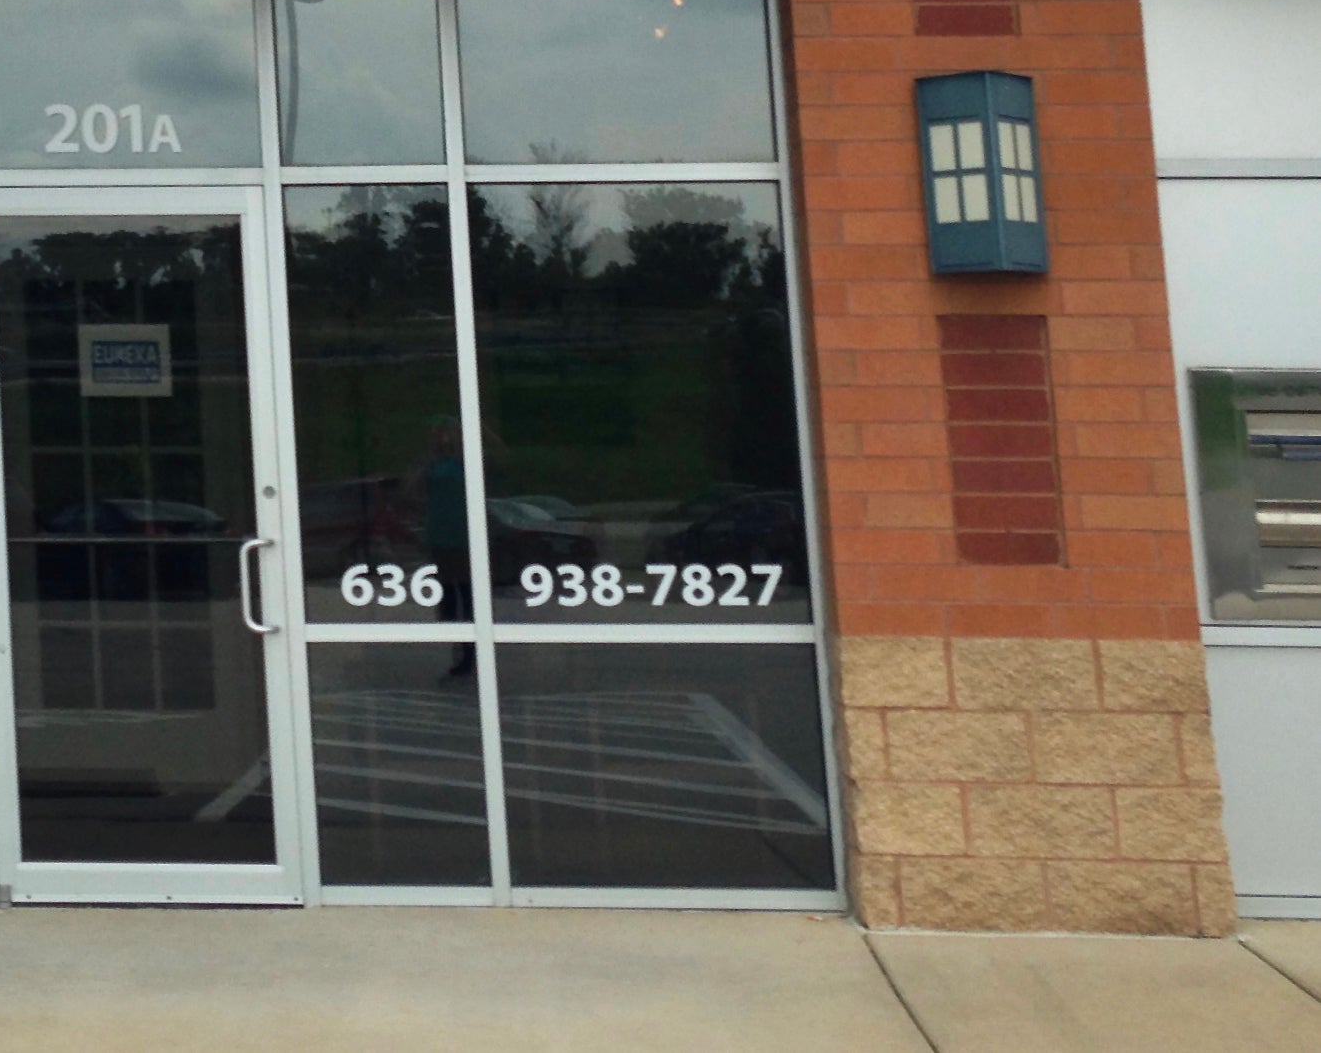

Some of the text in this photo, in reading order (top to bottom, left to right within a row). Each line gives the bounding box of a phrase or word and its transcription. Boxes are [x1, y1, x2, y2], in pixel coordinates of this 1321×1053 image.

[43, 103, 183, 154] 201A
[340, 562, 784, 608] 636 938-7827
